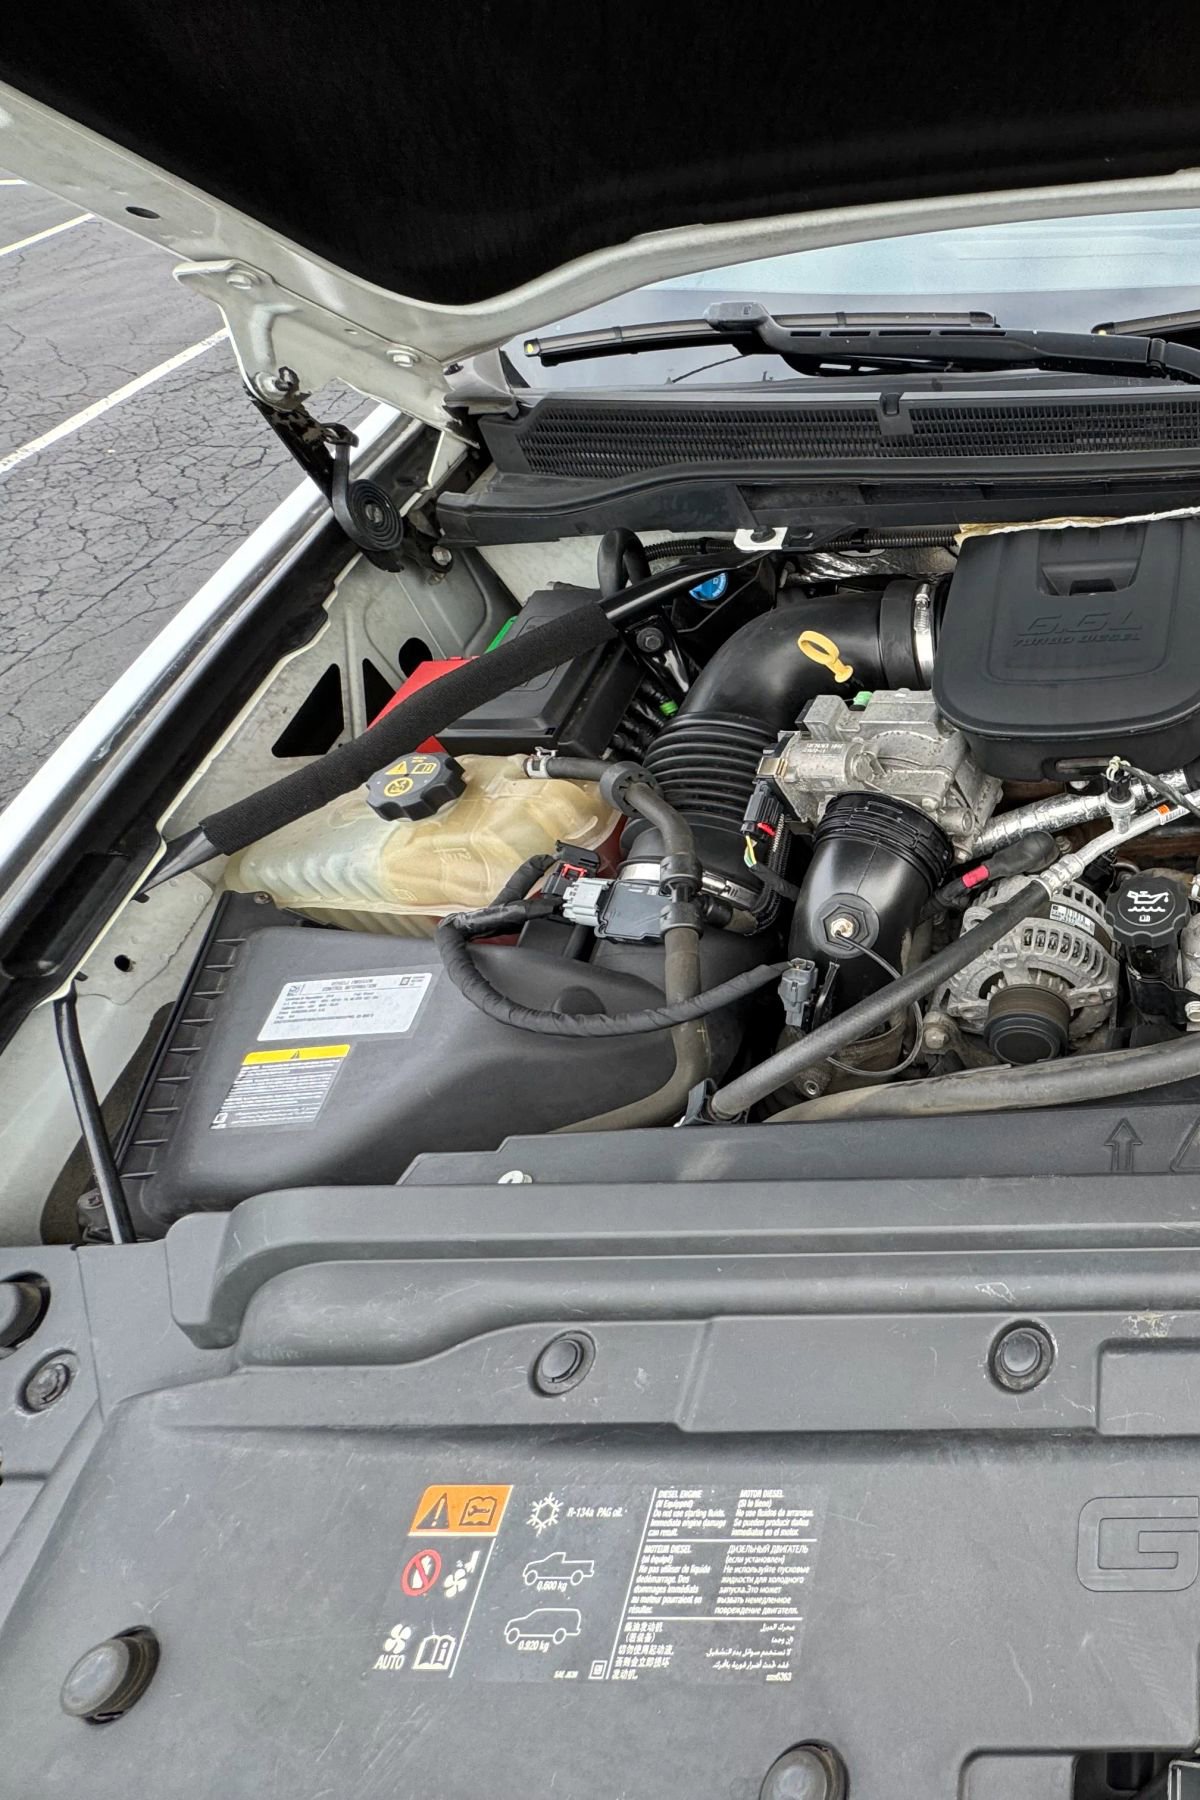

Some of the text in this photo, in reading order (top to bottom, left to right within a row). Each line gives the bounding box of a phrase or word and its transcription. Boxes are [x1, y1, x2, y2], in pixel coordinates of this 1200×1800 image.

[1077, 632, 1141, 644] DIESEL
[657, 1490, 703, 1498] DIESEL ENGINE
[740, 1489, 784, 1498] MOTOR DIESEL
[664, 1500, 693, 1509] Equipped)
[566, 1507, 594, 1517] R-134a
[596, 1507, 613, 1517] PAG
[653, 1509, 661, 1517] Do
[684, 1509, 707, 1519] starting
[757, 1509, 777, 1517] fluidos
[650, 1519, 726, 1529] Immediate engine damage
[742, 1519, 765, 1528] pueden
[765, 1519, 790, 1528] producir
[644, 1545, 692, 1553] MOTEUR DIESEL
[727, 1544, 808, 1554] ДИЗЕЛЬНЫЙ ДВИГАТЕЛЬ
[690, 1565, 711, 1575] liquide
[723, 1565, 810, 1575] Не используйте пусковые
[677, 1575, 690, 1583] Des
[721, 1576, 754, 1584] жидкости
[768, 1577, 804, 1585] холодного
[558, 1582, 567, 1592] kg
[634, 1585, 667, 1595] dommages
[640, 1595, 662, 1603] moteur
[661, 1595, 694, 1605] pourraient
[745, 1597, 791, 1605] немедленное
[715, 1607, 761, 1615] повреждение
[539, 1641, 550, 1653] kg
[372, 1655, 405, 1670] AUTO
